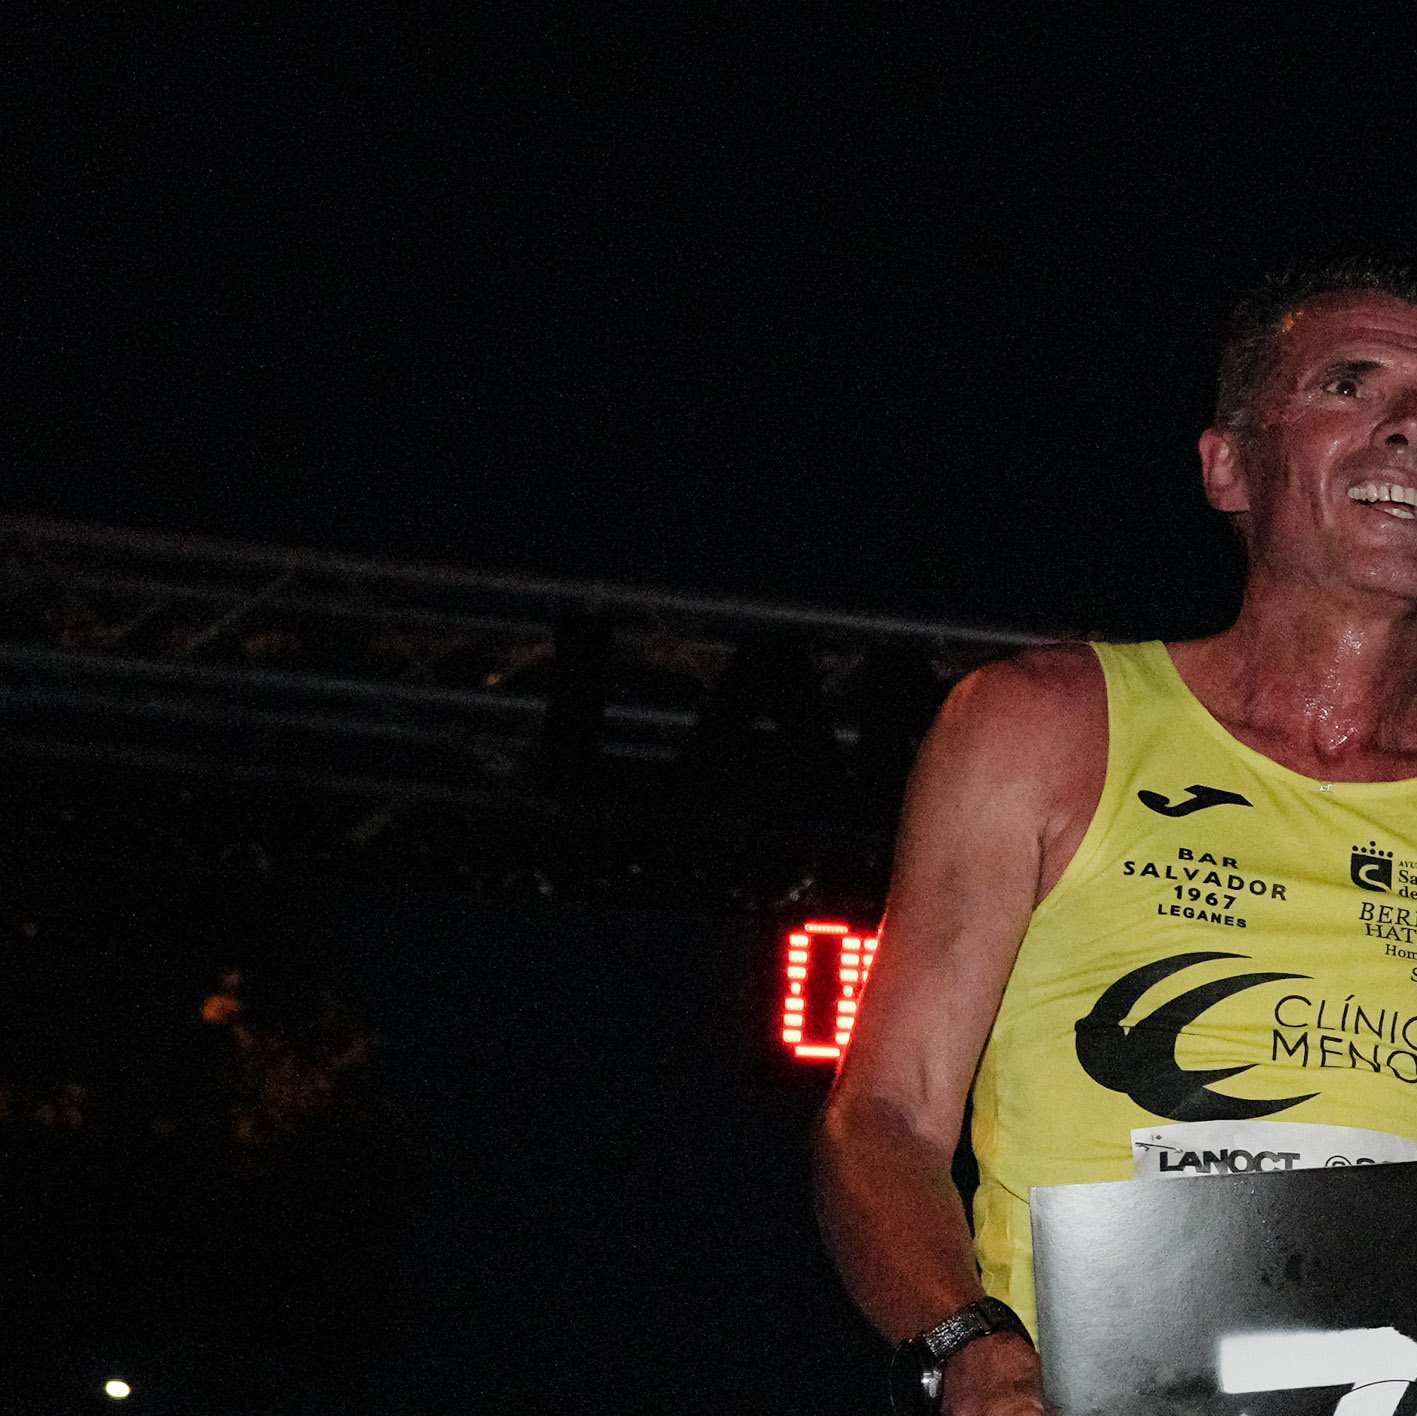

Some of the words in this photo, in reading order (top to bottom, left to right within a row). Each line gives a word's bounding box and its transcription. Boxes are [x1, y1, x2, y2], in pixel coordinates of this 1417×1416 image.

[1177, 847, 1239, 869] BAR
[1123, 861, 1288, 901] SALVADOR
[1173, 885, 1237, 910] 1967
[1157, 903, 1247, 928] LEGANES
